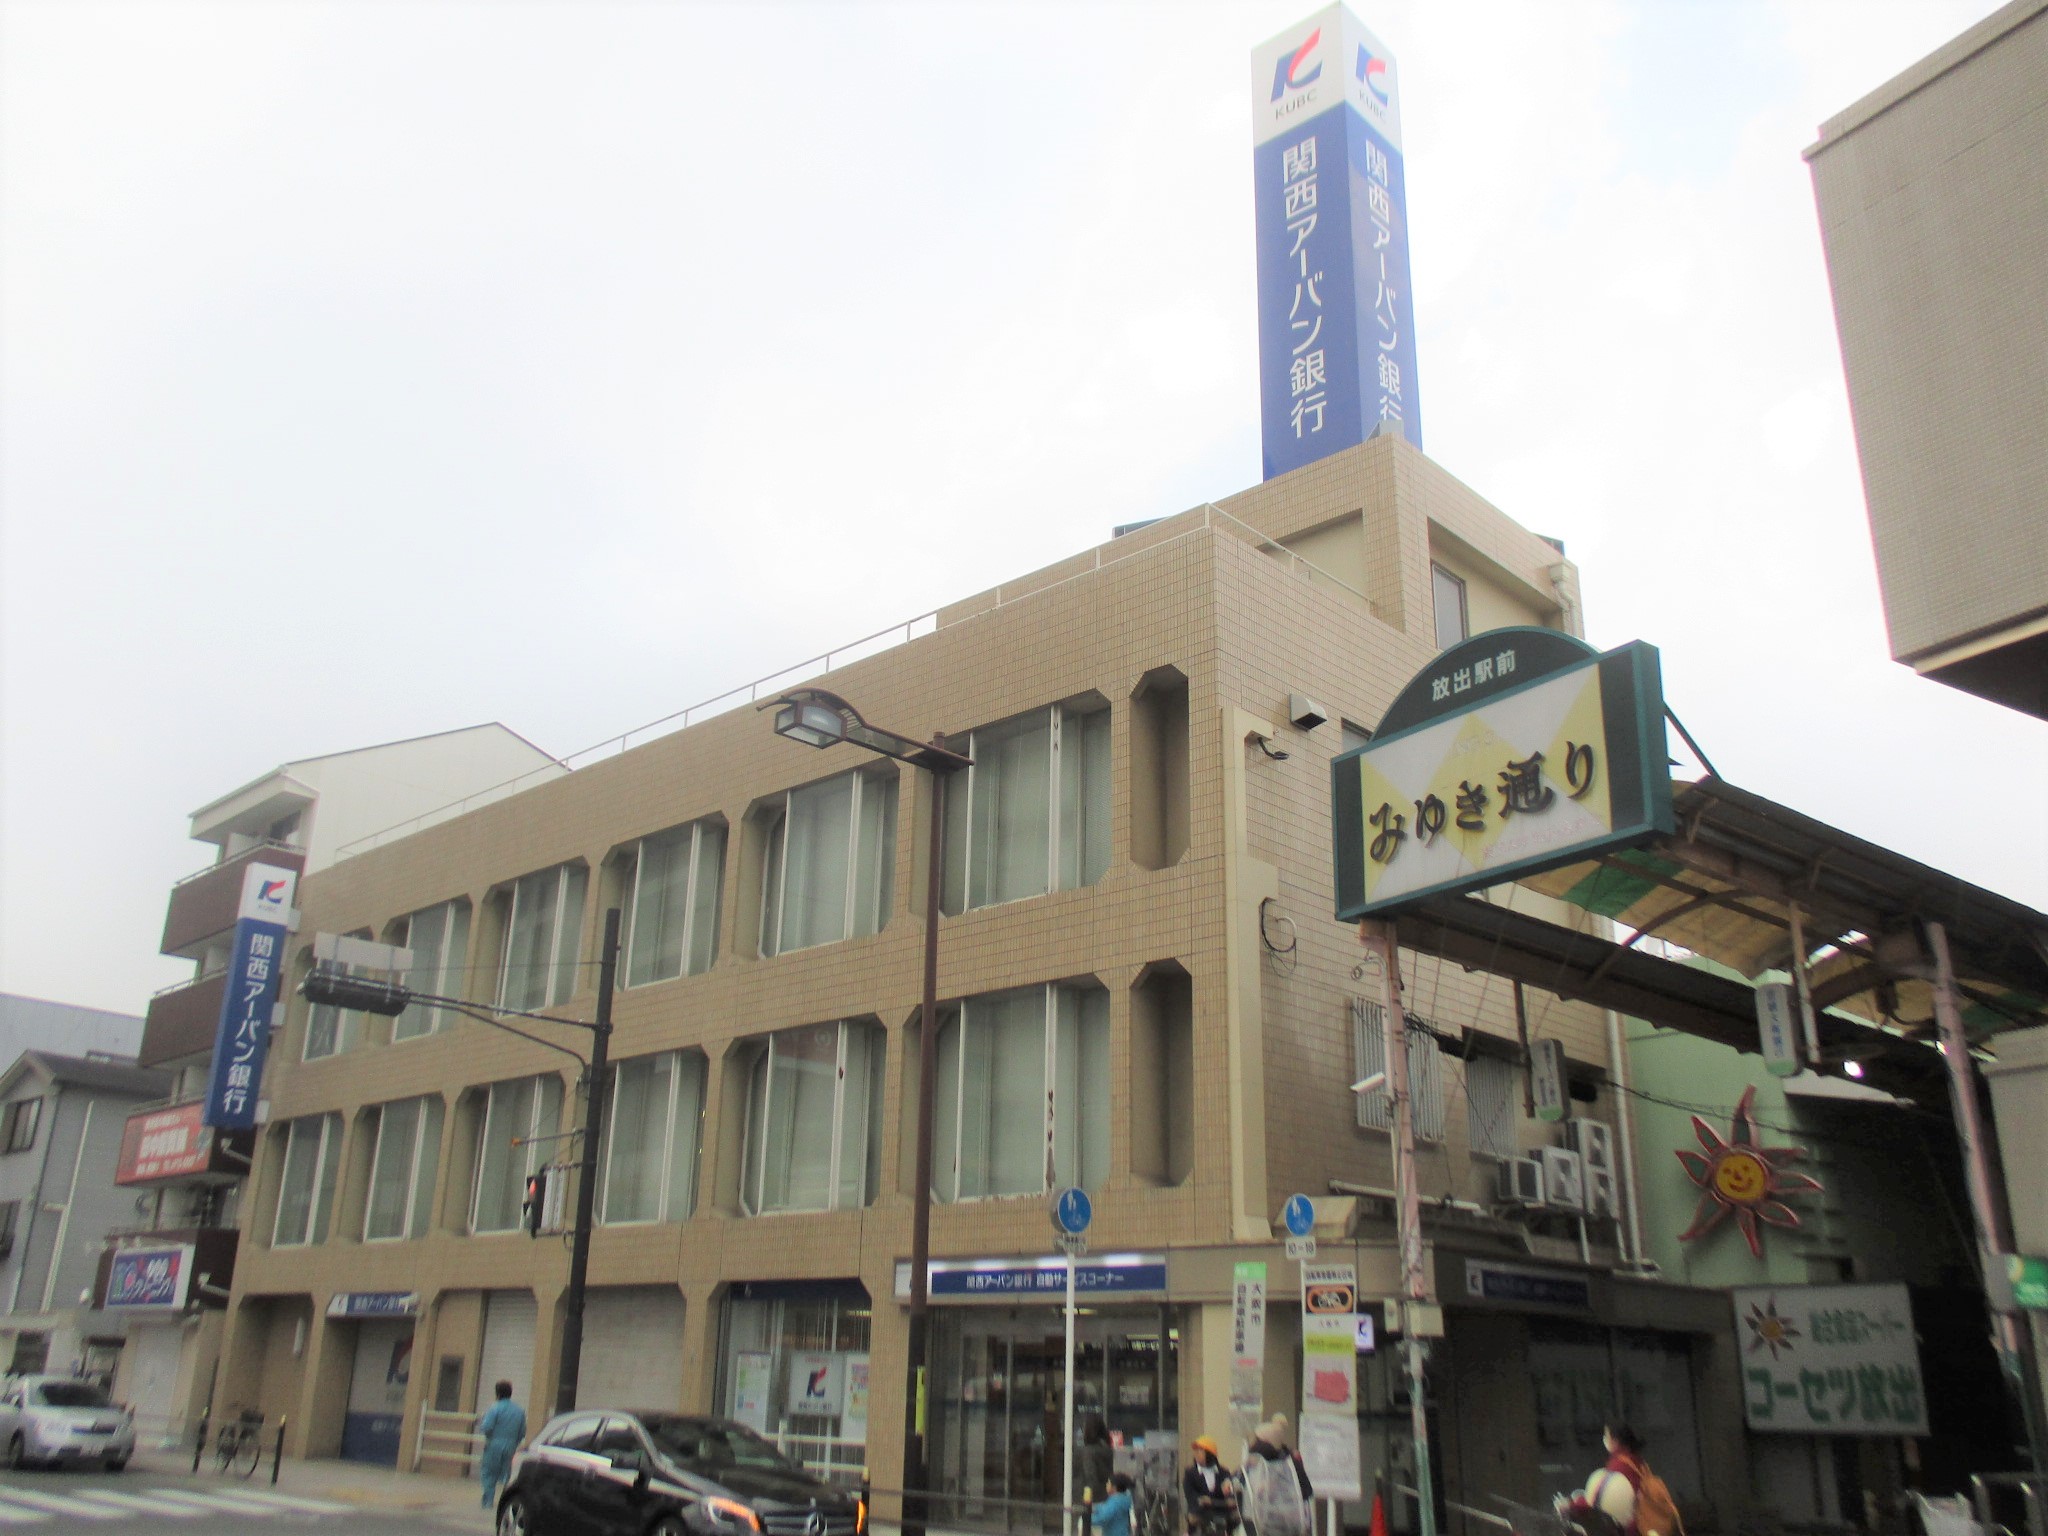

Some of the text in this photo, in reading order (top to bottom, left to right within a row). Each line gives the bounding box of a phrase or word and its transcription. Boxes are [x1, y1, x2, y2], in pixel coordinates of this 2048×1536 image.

[1274, 89, 1319, 121] KUBC
[1359, 90, 1388, 123] KUBC
[1282, 136, 1328, 438] 関西アーバン銀行
[1432, 649, 1516, 701] 放出駅前
[1369, 741, 1595, 862] みゆき通り
[223, 932, 274, 1115] 関西アーバン銀行
